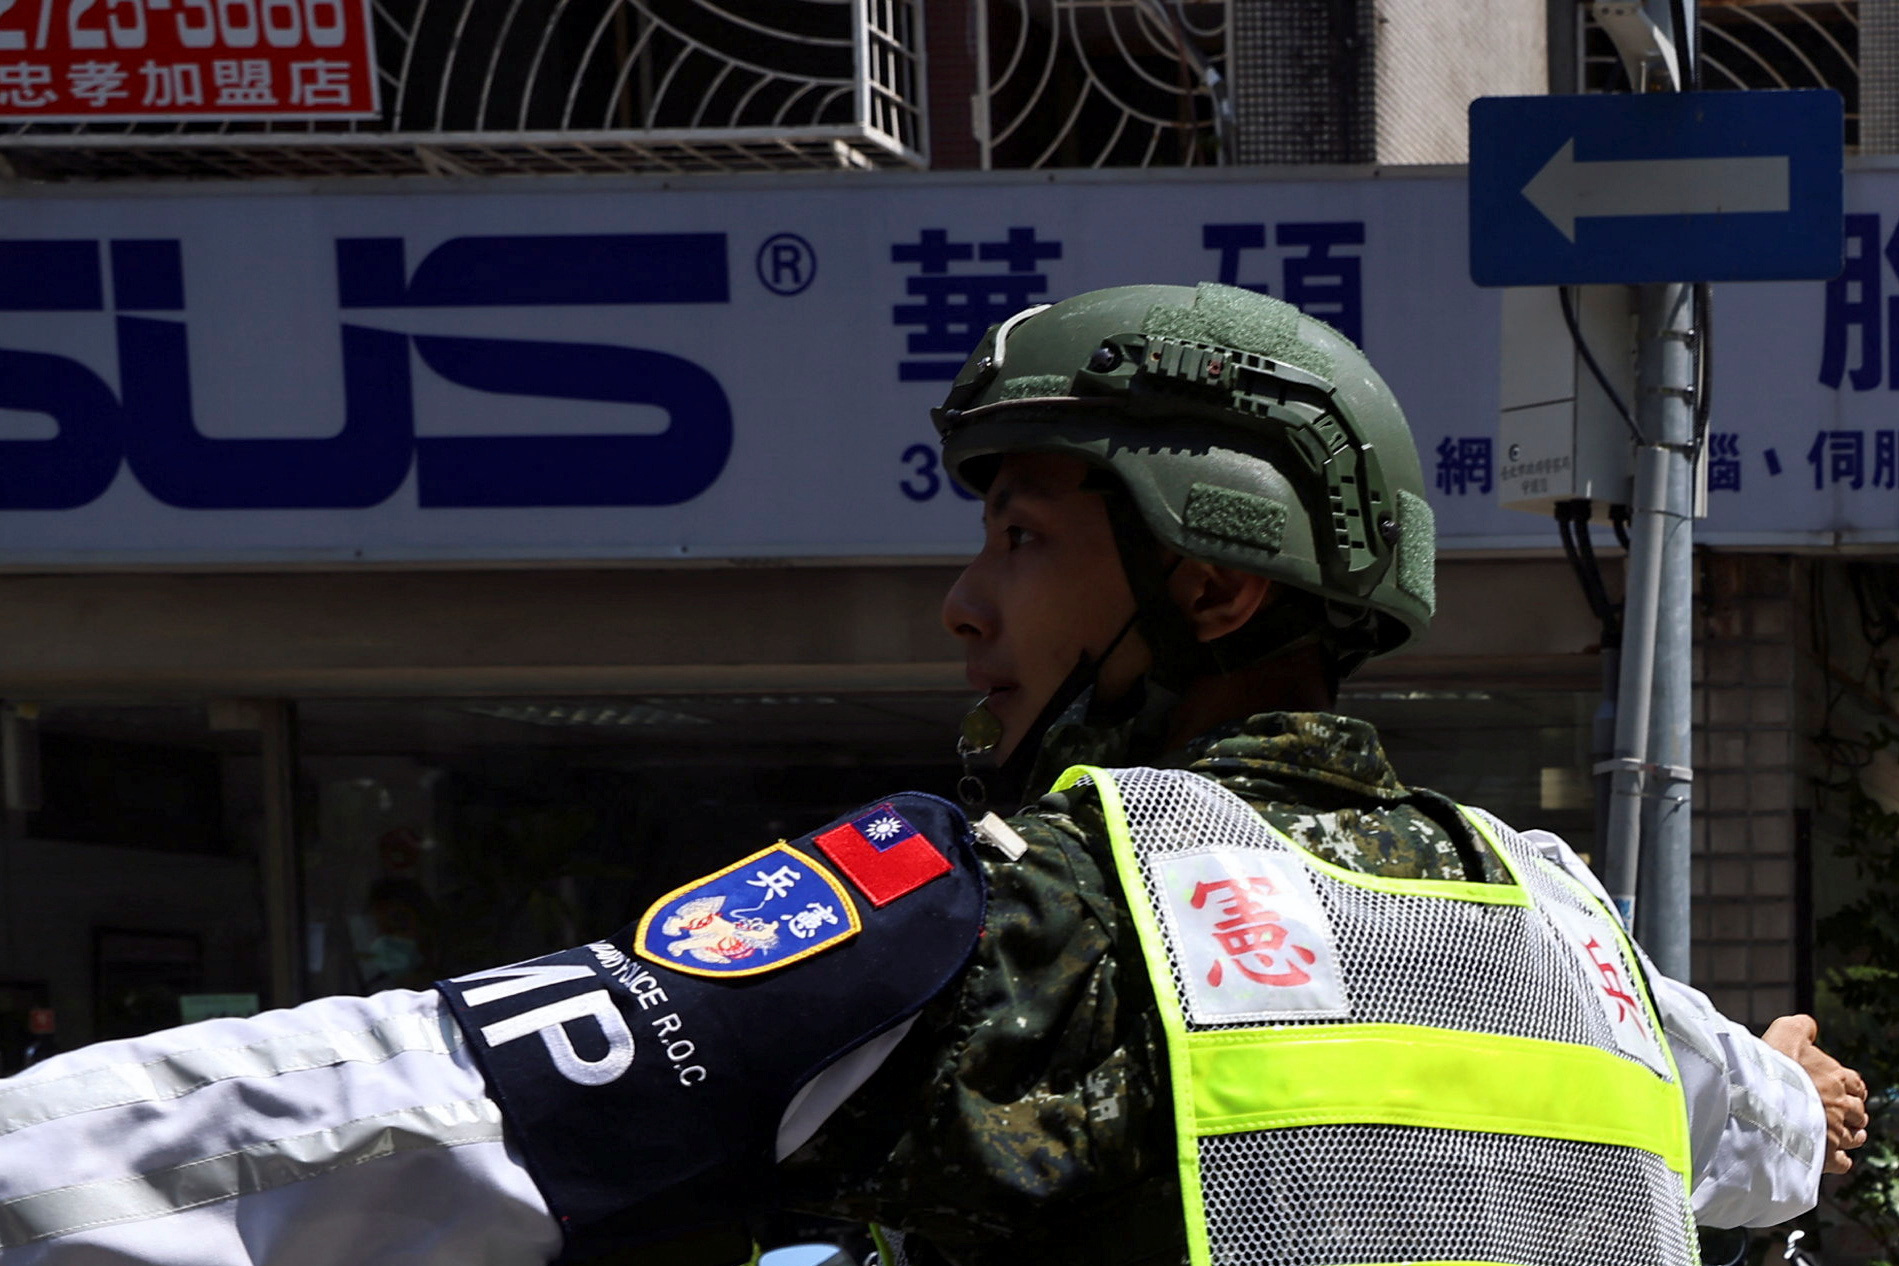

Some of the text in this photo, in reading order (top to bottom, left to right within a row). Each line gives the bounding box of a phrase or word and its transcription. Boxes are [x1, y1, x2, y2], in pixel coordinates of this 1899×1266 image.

[0, 58, 352, 108] 忠孝加盟店
[1189, 876, 1316, 988] 憲
